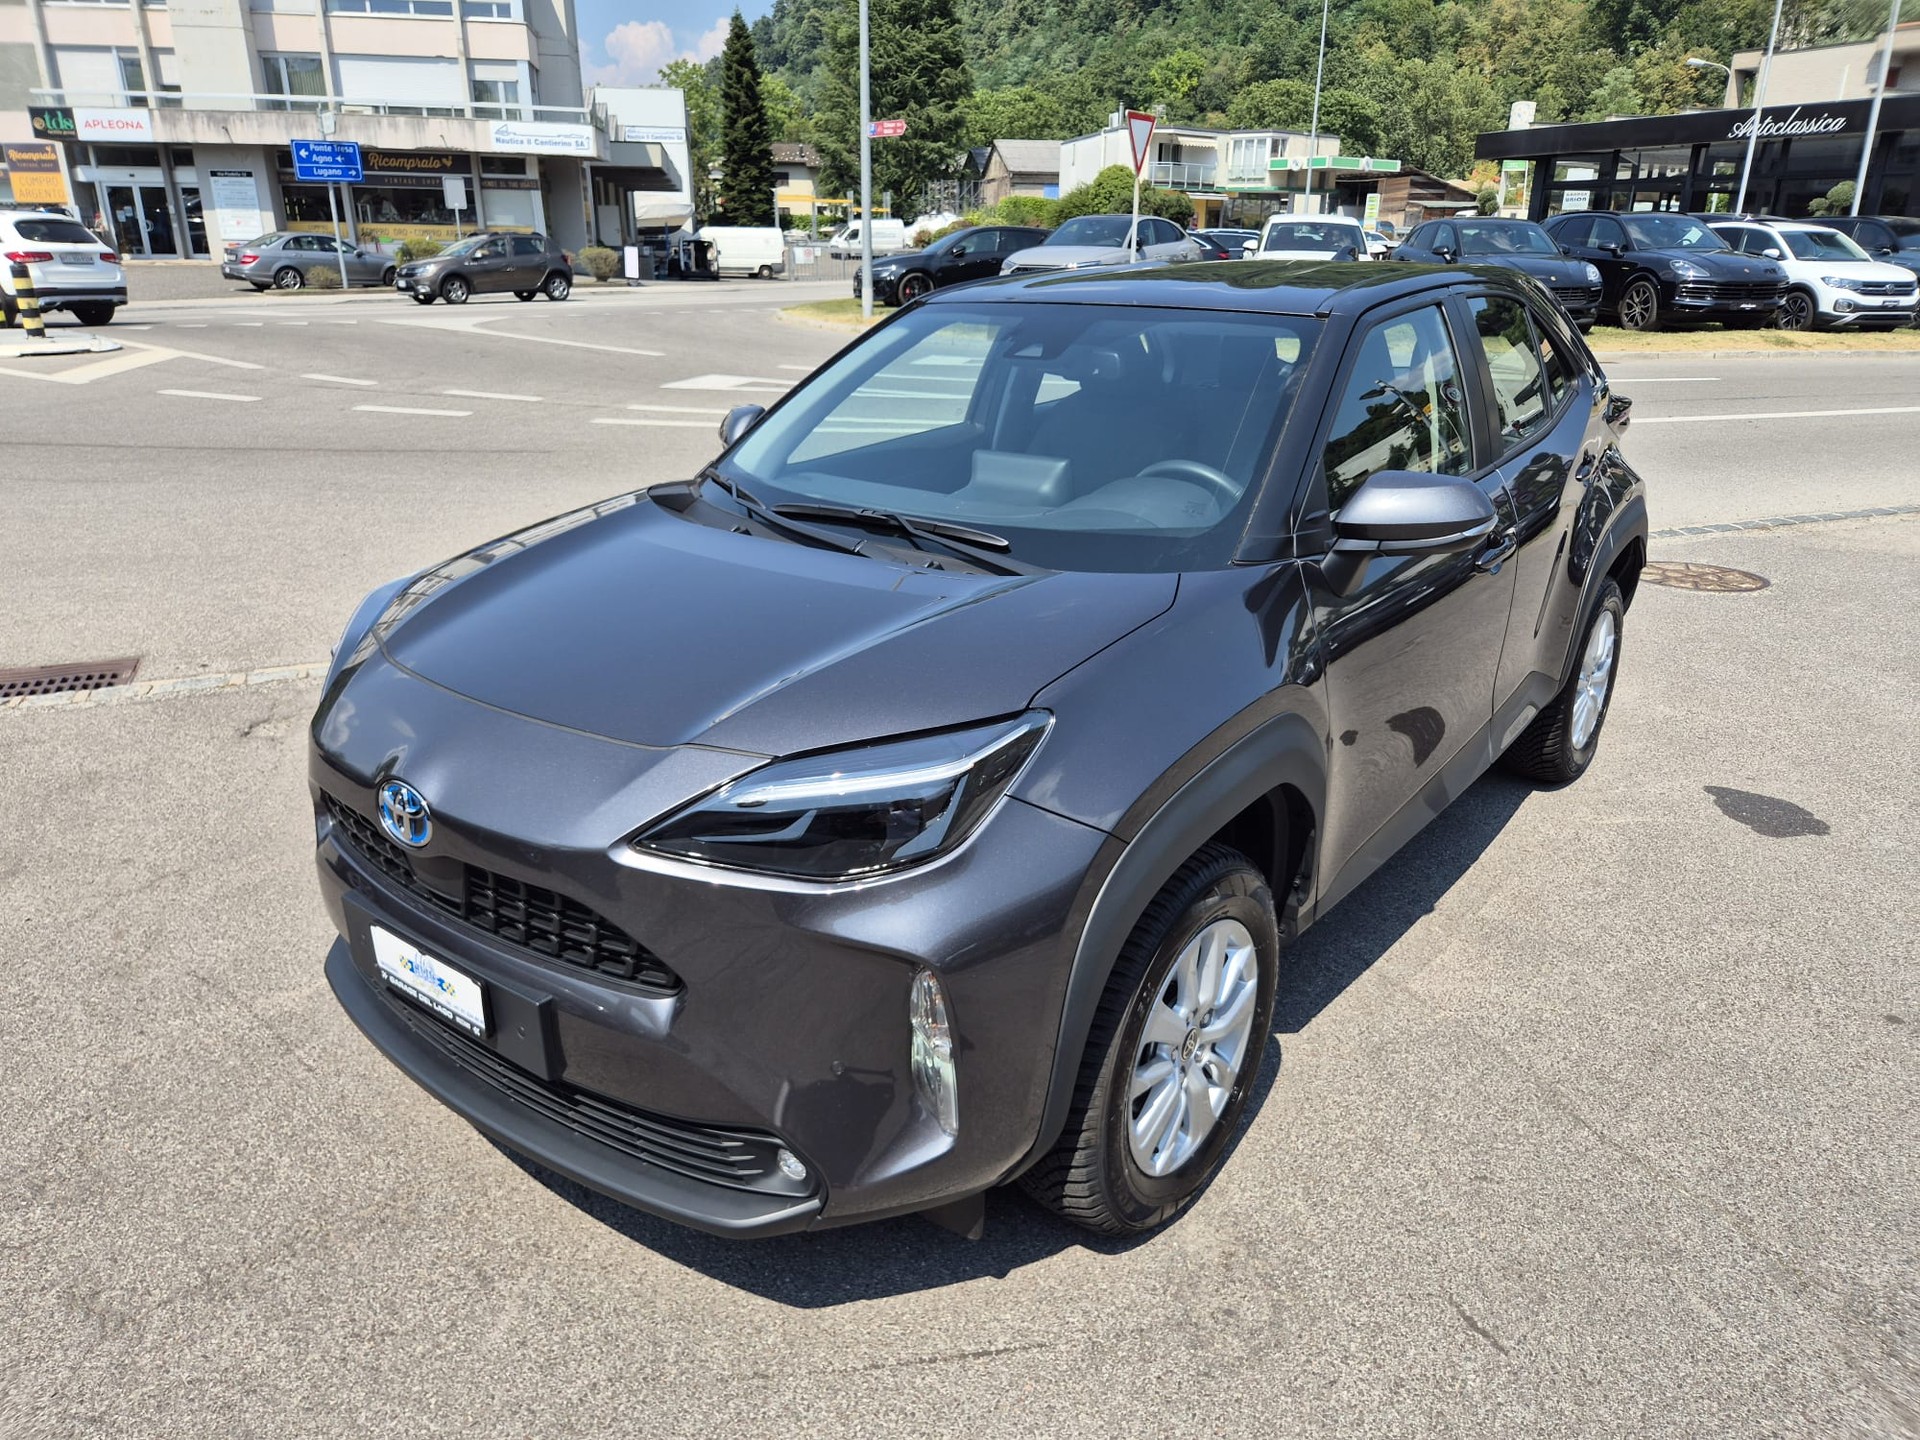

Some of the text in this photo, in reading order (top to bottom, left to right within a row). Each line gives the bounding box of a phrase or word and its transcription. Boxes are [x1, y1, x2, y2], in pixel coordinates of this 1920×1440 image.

[84, 119, 144, 130] APLEONA
[495, 137, 524, 145] Nautica
[534, 138, 572, 147] Cantierino
[575, 140, 586, 148] SA
[309, 143, 354, 153] Ponte Tresa
[312, 154, 333, 164] Agno
[368, 152, 442, 170] Ricompralo
[313, 167, 342, 177] Lugano
